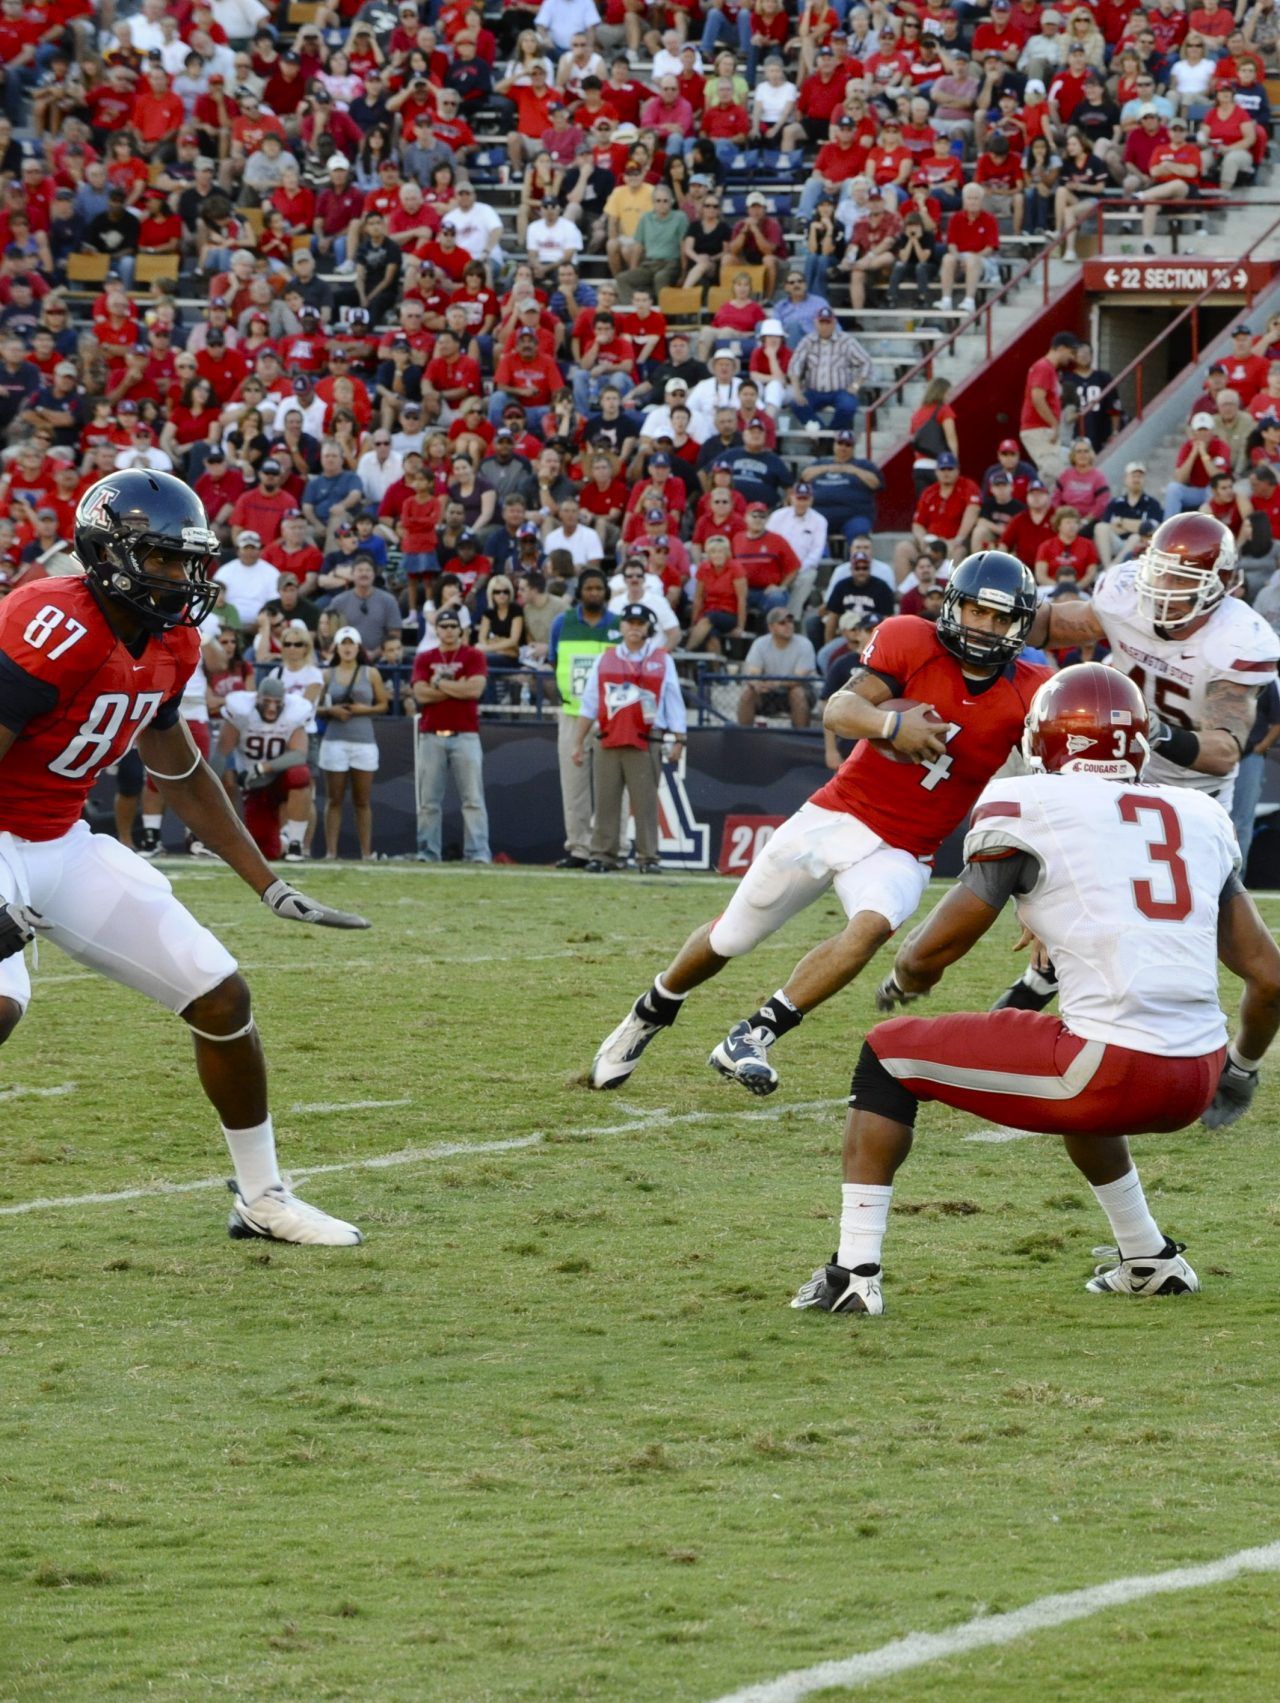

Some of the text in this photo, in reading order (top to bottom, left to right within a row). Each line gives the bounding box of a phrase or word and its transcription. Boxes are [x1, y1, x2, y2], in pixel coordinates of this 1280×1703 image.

[1120, 267, 1141, 289] 22
[1144, 267, 1208, 289] SECTION
[22, 604, 88, 661] 87
[861, 628, 880, 666] 4
[1170, 665, 1195, 686] STATE
[48, 690, 164, 780] 87
[244, 735, 287, 761] 90
[1112, 730, 1126, 758] 3
[1083, 763, 1118, 774] COUGARS
[1115, 792, 1195, 924] 3
